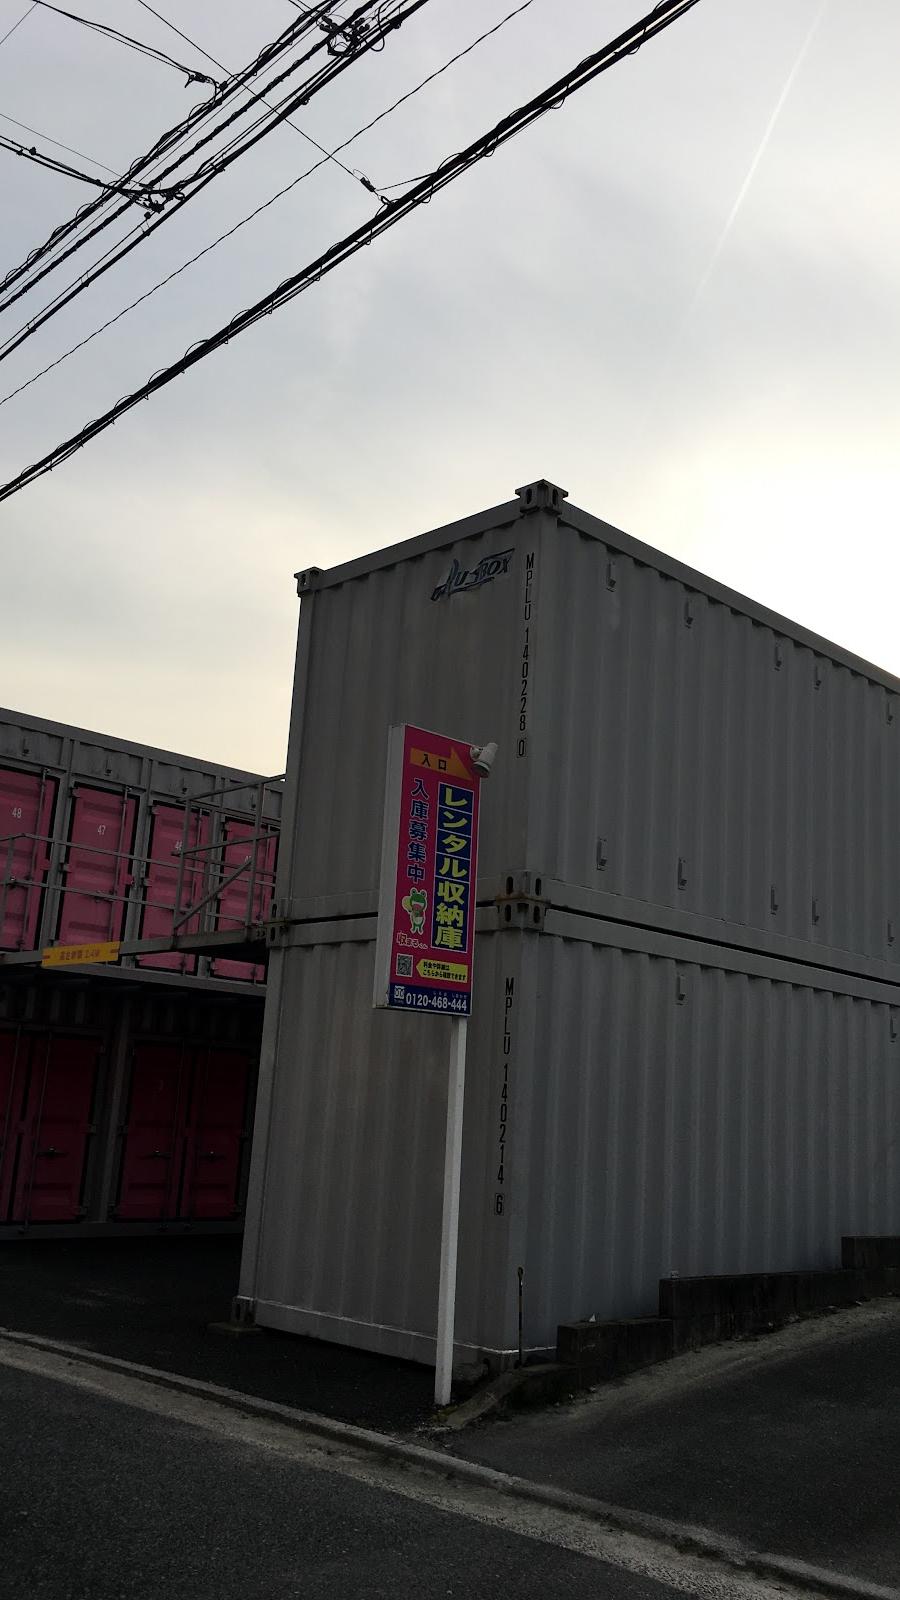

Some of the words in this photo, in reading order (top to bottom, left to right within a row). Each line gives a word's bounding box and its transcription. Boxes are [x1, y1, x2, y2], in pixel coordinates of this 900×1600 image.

[524, 552, 535, 621] MPLU
[519, 627, 529, 732] 140228
[422, 753, 447, 771] 入口
[12, 807, 22, 818] 48
[97, 824, 106, 835] 47
[407, 778, 429, 884] 入庫募集中
[435, 786, 468, 948] レンタル収納庫
[405, 992, 467, 1011] 0120-468-444
[503, 977, 514, 1055] MPLU
[497, 1063, 508, 1184] 140214
